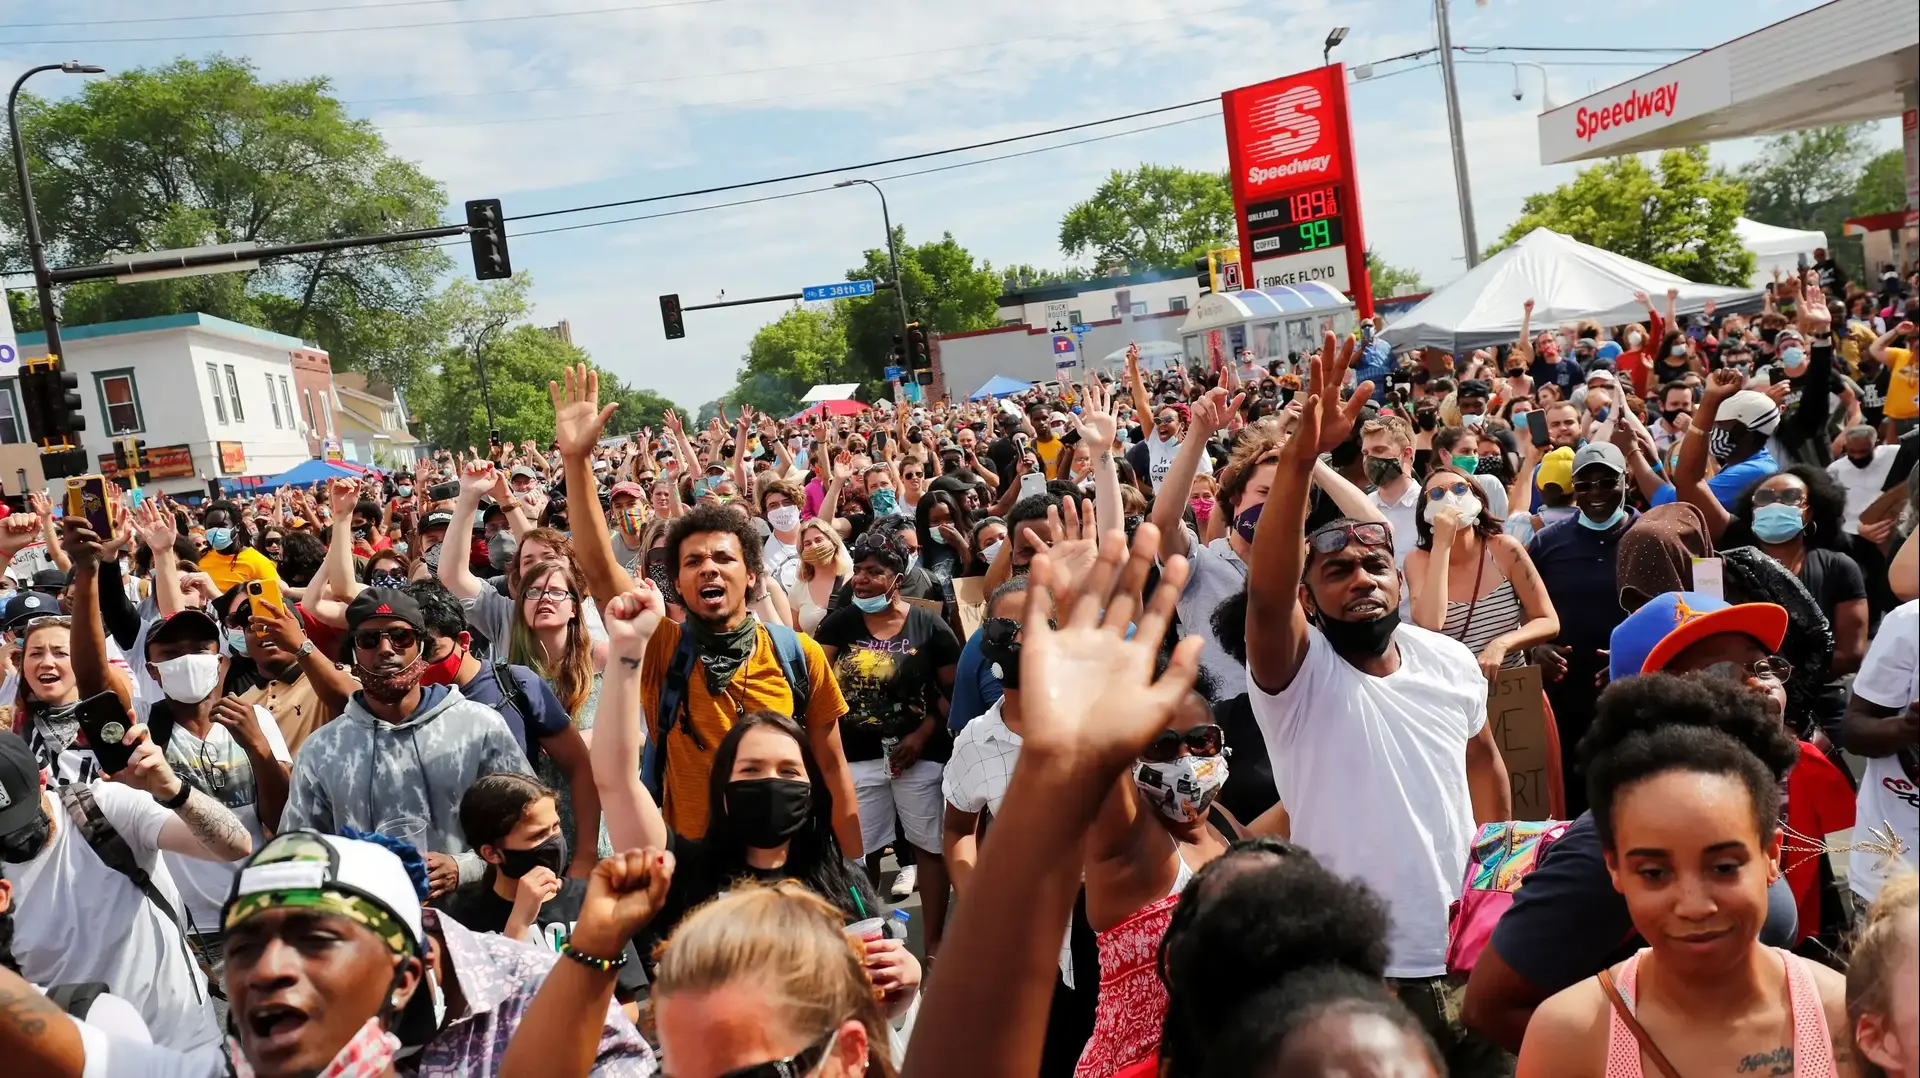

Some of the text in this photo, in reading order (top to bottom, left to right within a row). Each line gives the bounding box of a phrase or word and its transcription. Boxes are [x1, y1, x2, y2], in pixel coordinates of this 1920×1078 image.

[1576, 81, 1678, 142] Speedway
[1247, 154, 1331, 186] Speedway
[1255, 238, 1279, 250] COFFEE
[1299, 265, 1335, 283] FLOYD
[818, 282, 871, 297] E 38th St
[1047, 303, 1067, 312] TRUCK
[1047, 311, 1067, 319] ROUTE
[12, 551, 39, 565] Justice
